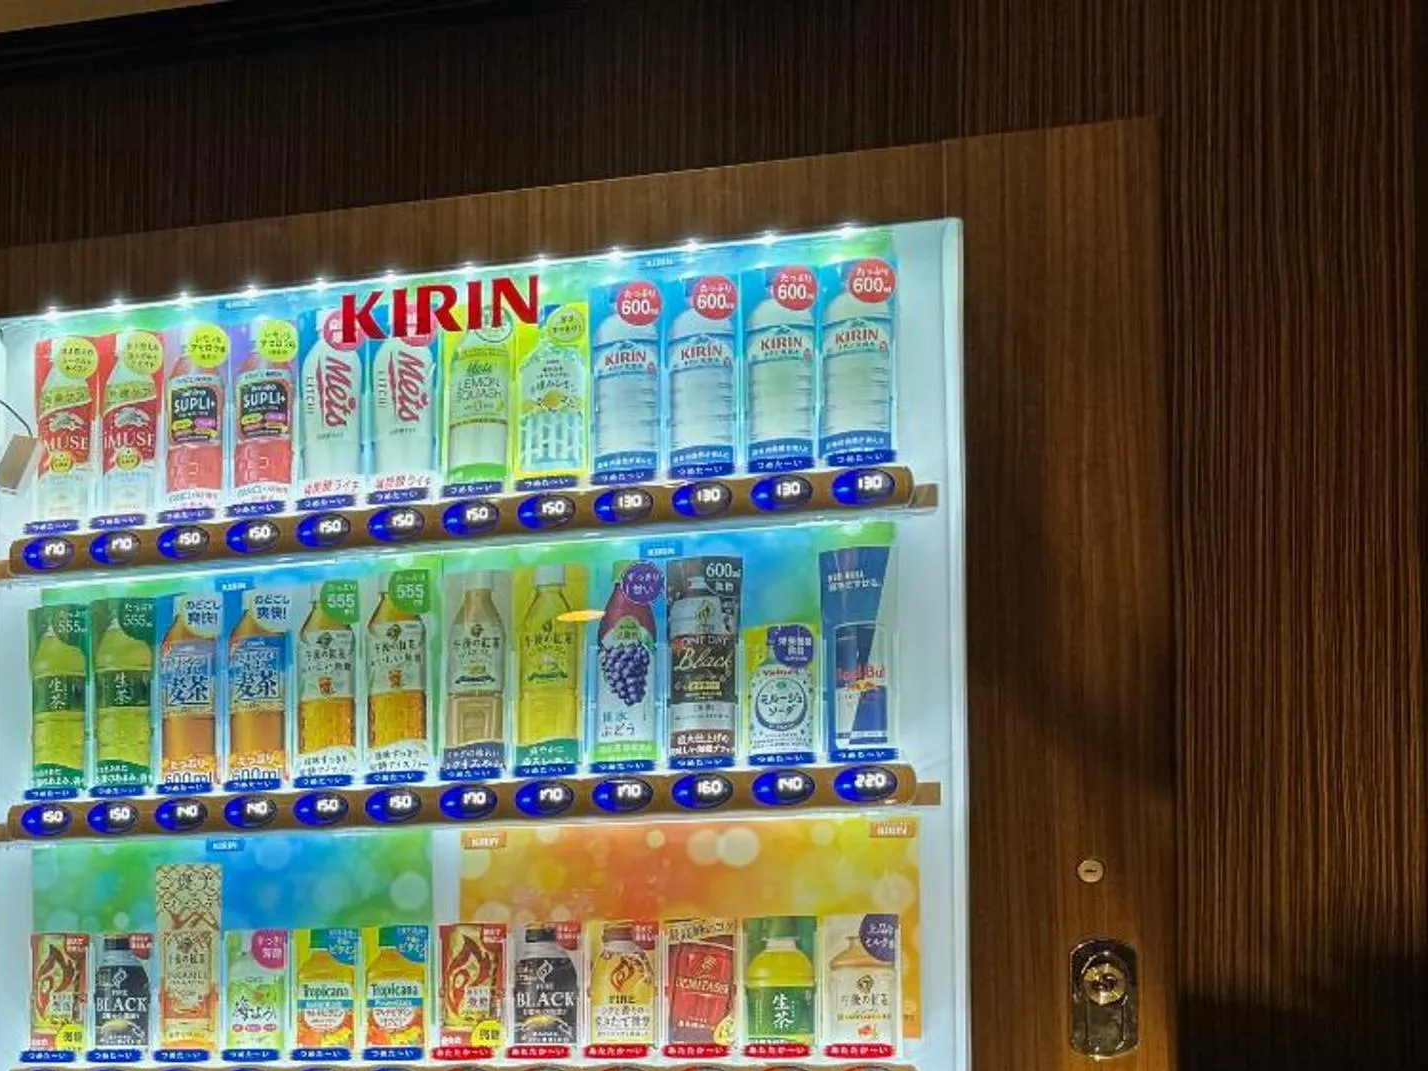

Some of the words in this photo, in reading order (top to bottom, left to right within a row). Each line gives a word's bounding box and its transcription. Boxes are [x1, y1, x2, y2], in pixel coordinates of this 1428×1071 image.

[341, 275, 539, 343] KIRIN
[760, 336, 803, 351] KIRIN
[835, 329, 879, 345] KIRIN
[604, 351, 647, 366] KIRIN
[680, 345, 723, 361] KIRIN
[673, 647, 733, 671] Black
[302, 984, 349, 998] Tropicana
[371, 982, 419, 998] Tropicana
[95, 997, 147, 1011] BLACK
[516, 991, 575, 1007] BLACK
[772, 993, 795, 1029] 生茶
